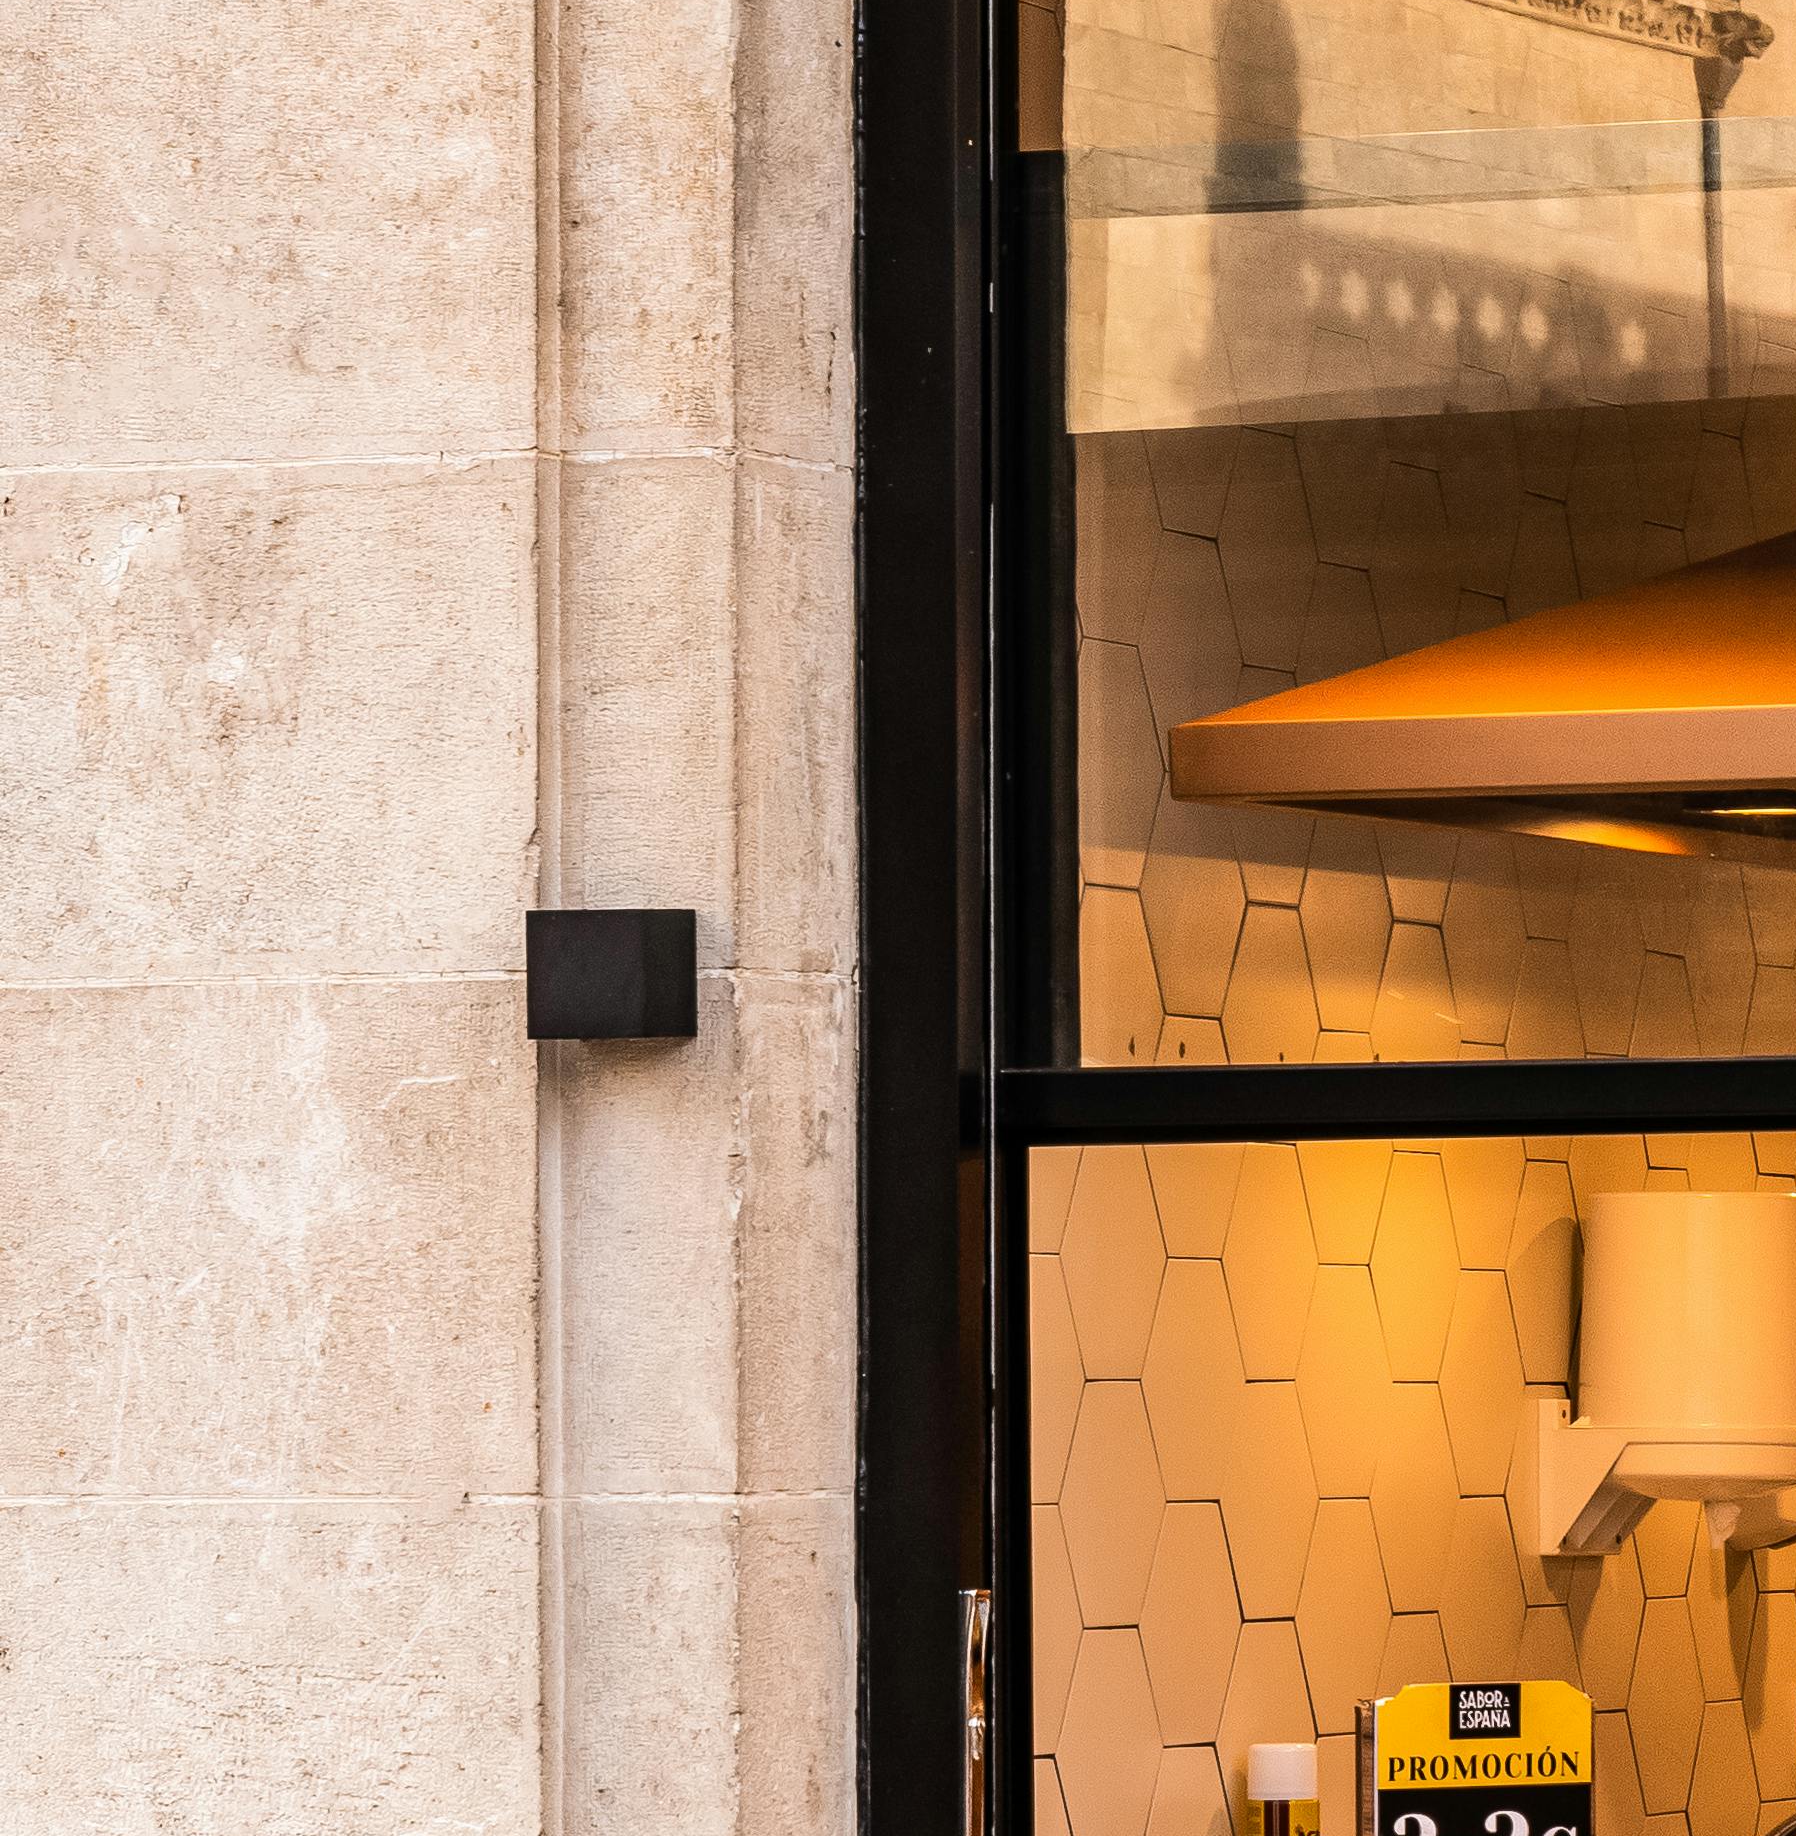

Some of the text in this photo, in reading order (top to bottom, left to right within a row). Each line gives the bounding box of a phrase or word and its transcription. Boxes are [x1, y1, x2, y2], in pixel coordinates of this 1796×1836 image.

[1458, 1689, 1511, 1709] SABOR A
[1459, 1709, 1512, 1729] ESPAÑA
[1387, 1746, 1580, 1782] PROMOCIÓN
